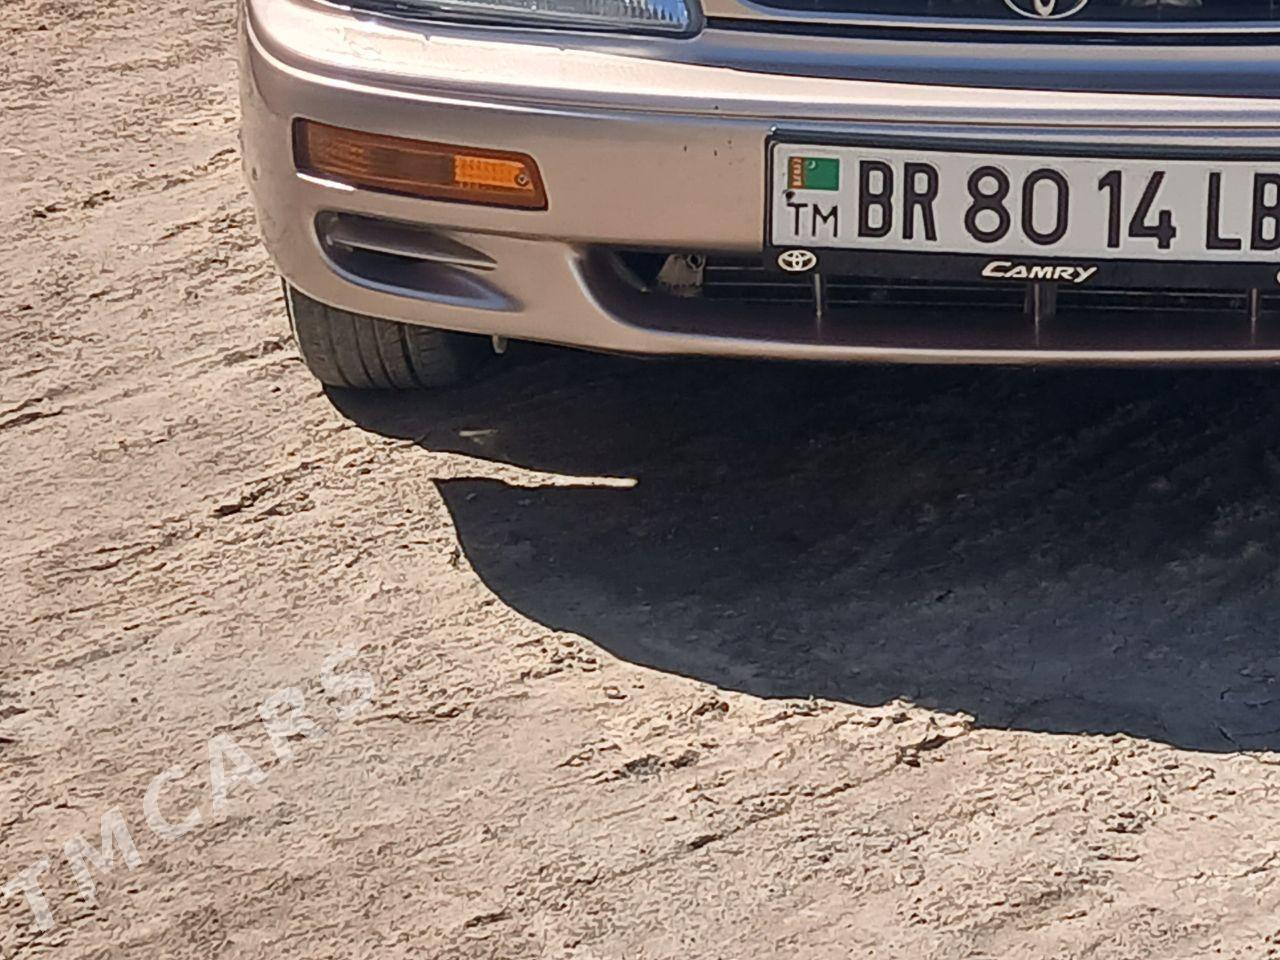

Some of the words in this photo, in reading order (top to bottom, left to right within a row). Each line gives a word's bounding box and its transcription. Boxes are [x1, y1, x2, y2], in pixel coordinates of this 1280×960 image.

[787, 202, 838, 237] TM
[858, 160, 939, 241] BR
[964, 165, 1069, 246] 80
[1098, 170, 1176, 250] 14
[981, 261, 1098, 283] CAMRY
